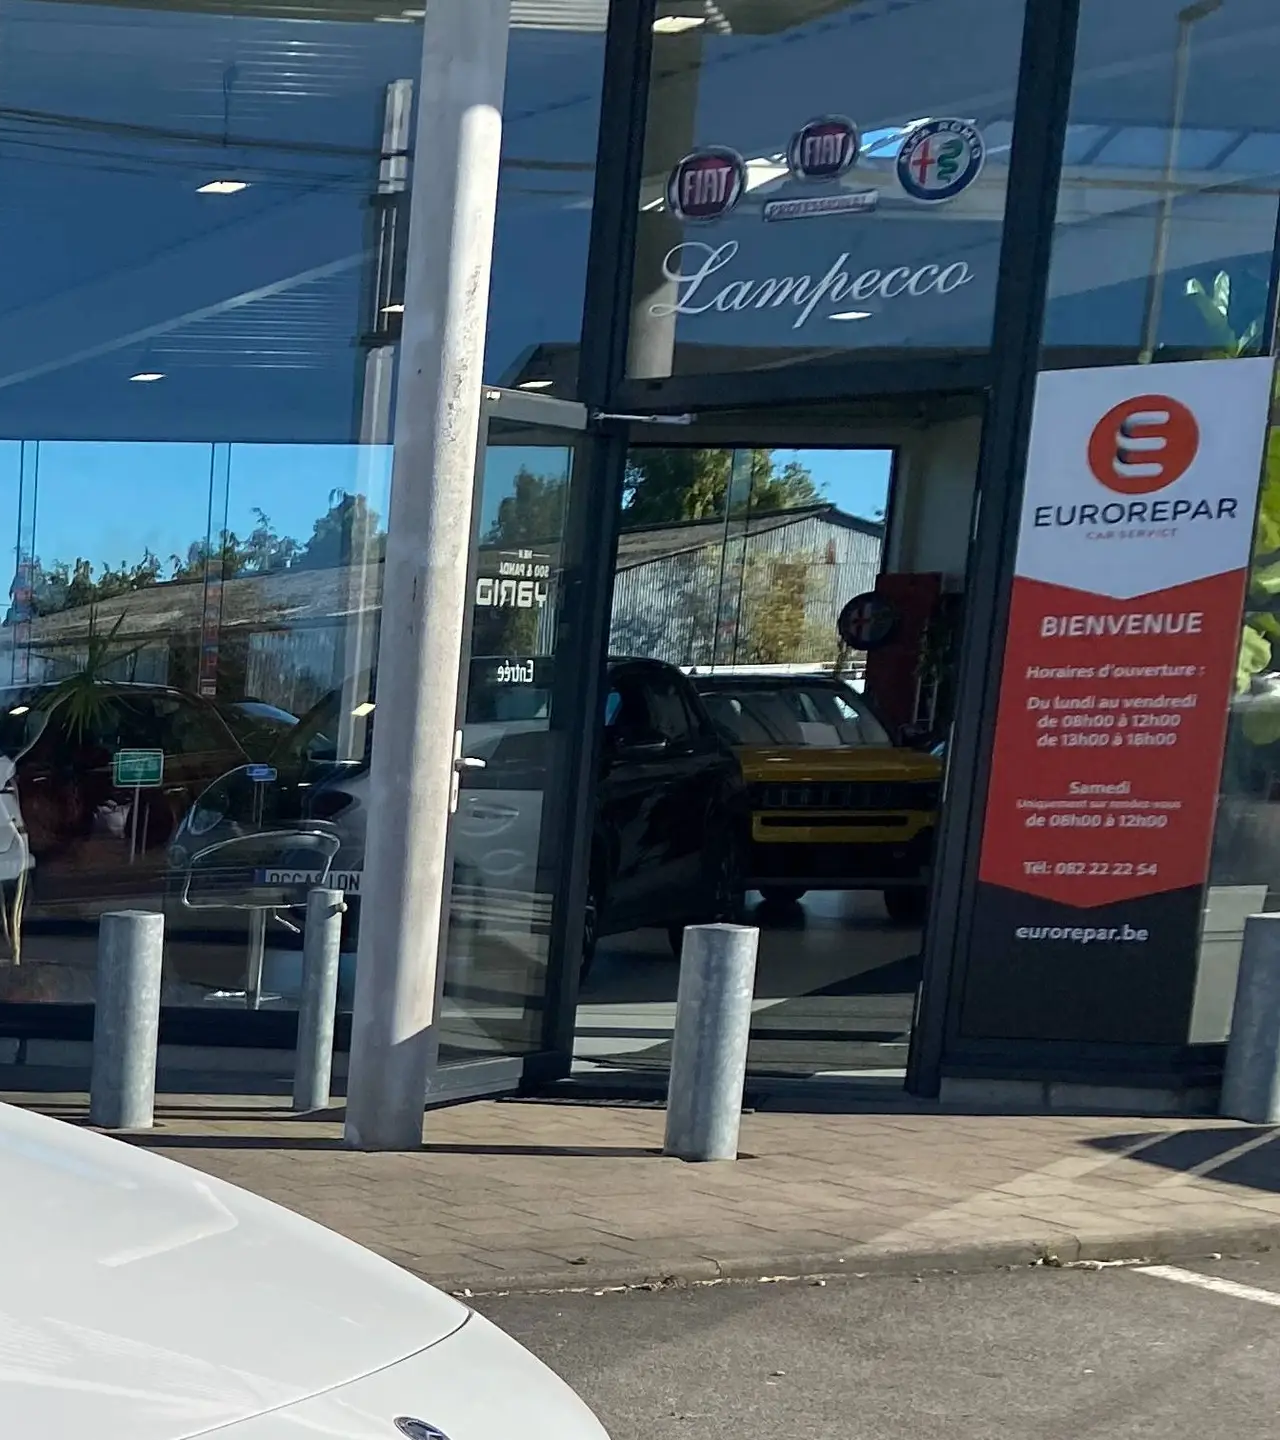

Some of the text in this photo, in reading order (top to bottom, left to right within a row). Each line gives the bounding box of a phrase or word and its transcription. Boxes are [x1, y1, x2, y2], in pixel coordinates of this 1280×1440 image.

[805, 132, 847, 164] FIAT
[938, 122, 981, 159] ROMEO
[683, 167, 732, 205] FIAT
[649, 239, 975, 329] Lampecco
[1034, 498, 1238, 527] EUROREPAR
[1041, 612, 1204, 637] BIENVENUE
[1026, 665, 1094, 679] Horaires
[1098, 664, 1196, 678] d'ouverture
[1027, 694, 1197, 709] Du lundi au vendredi
[1037, 715, 1058, 728] de
[1118, 713, 1128, 727] à
[1132, 714, 1181, 727] 12h00
[1037, 733, 1058, 747] de
[1061, 733, 1109, 747] 13h00
[1113, 732, 1123, 746] à
[1069, 781, 1131, 795] Samedi
[1025, 814, 1046, 828] de
[1104, 813, 1115, 827] à
[1119, 814, 1168, 828] 12h00
[1054, 862, 1085, 875] 082
[1088, 862, 1109, 875] 22
[1112, 862, 1132, 875] 22
[1015, 923, 1149, 944] eurorepar.be
